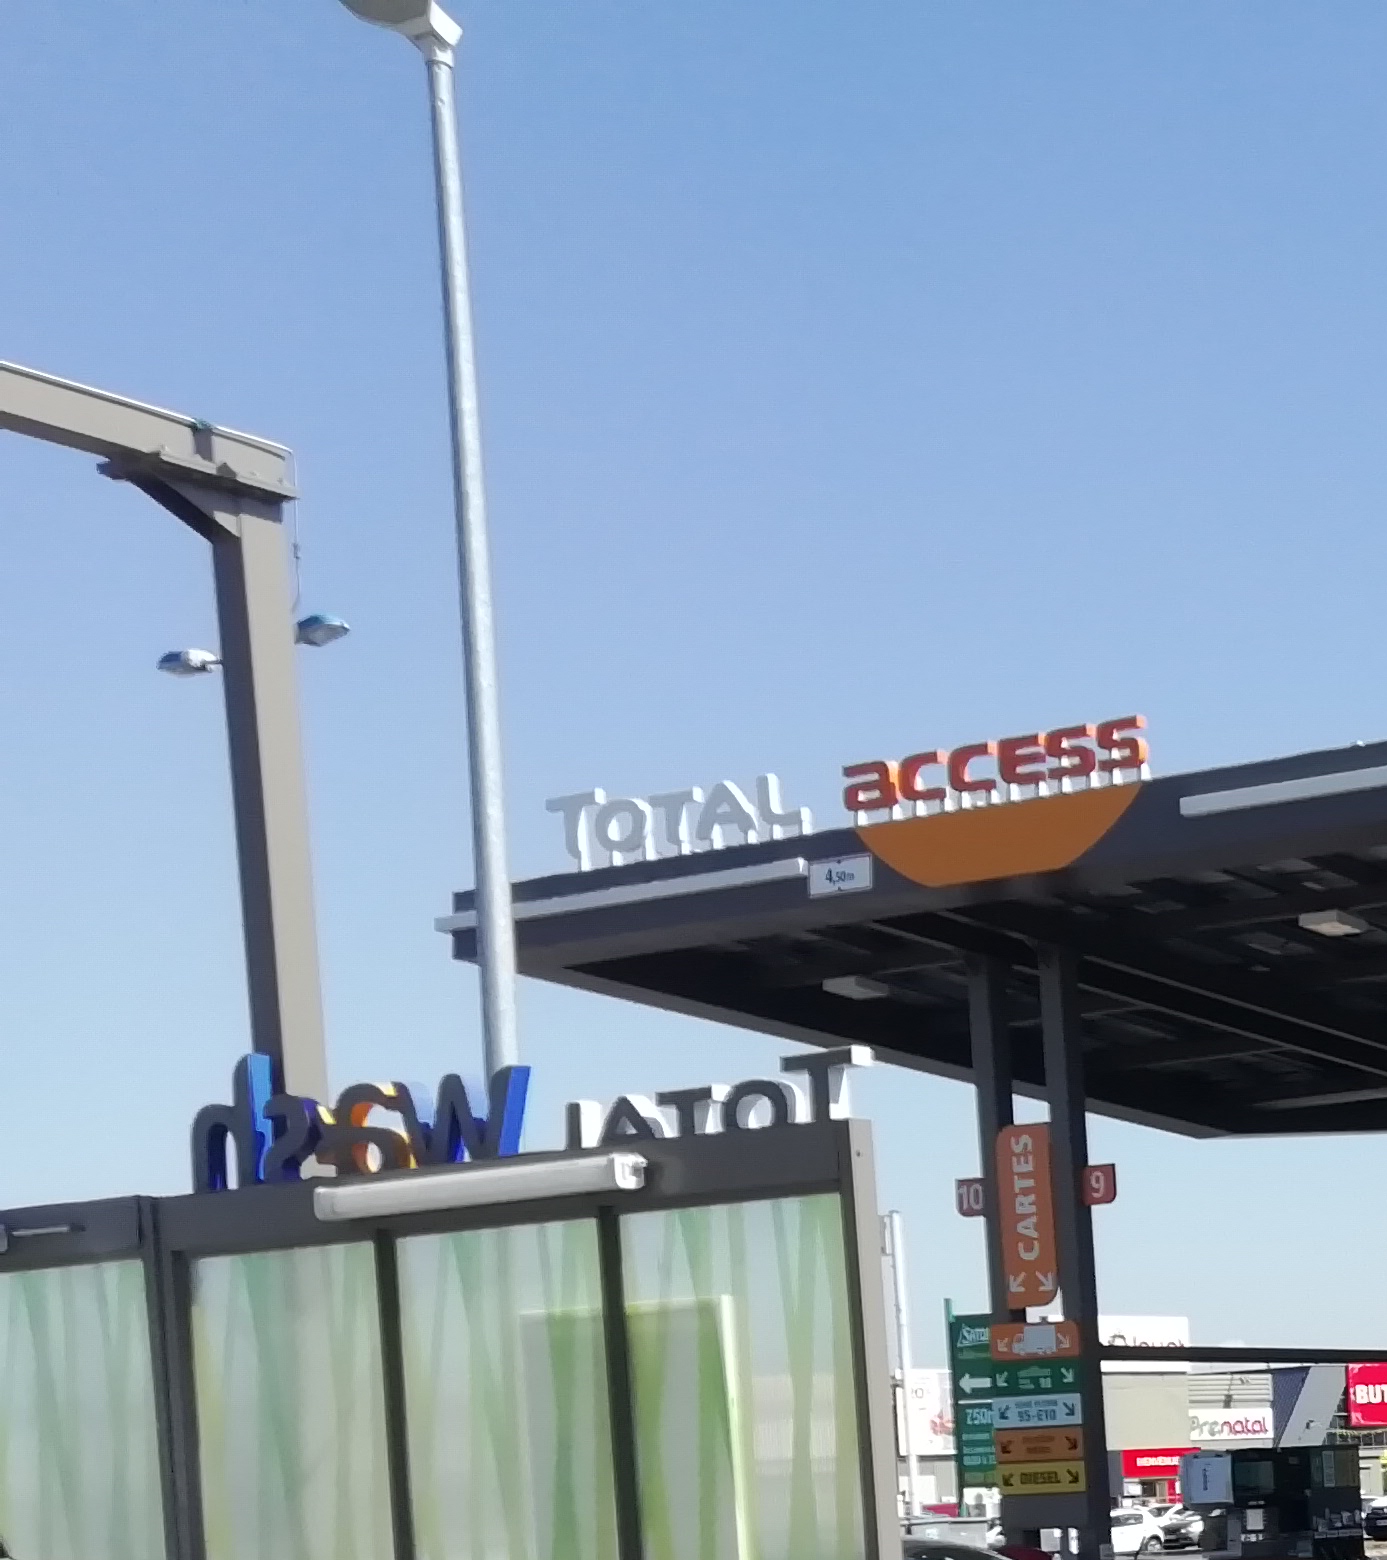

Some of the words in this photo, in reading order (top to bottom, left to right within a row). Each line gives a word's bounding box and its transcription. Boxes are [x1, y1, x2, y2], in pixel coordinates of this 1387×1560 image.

[546, 773, 811, 859] TOTAL
[957, 1182, 984, 1211] 10
[1010, 1134, 1041, 1261] CARTES
[1089, 1170, 1105, 1199] 9
